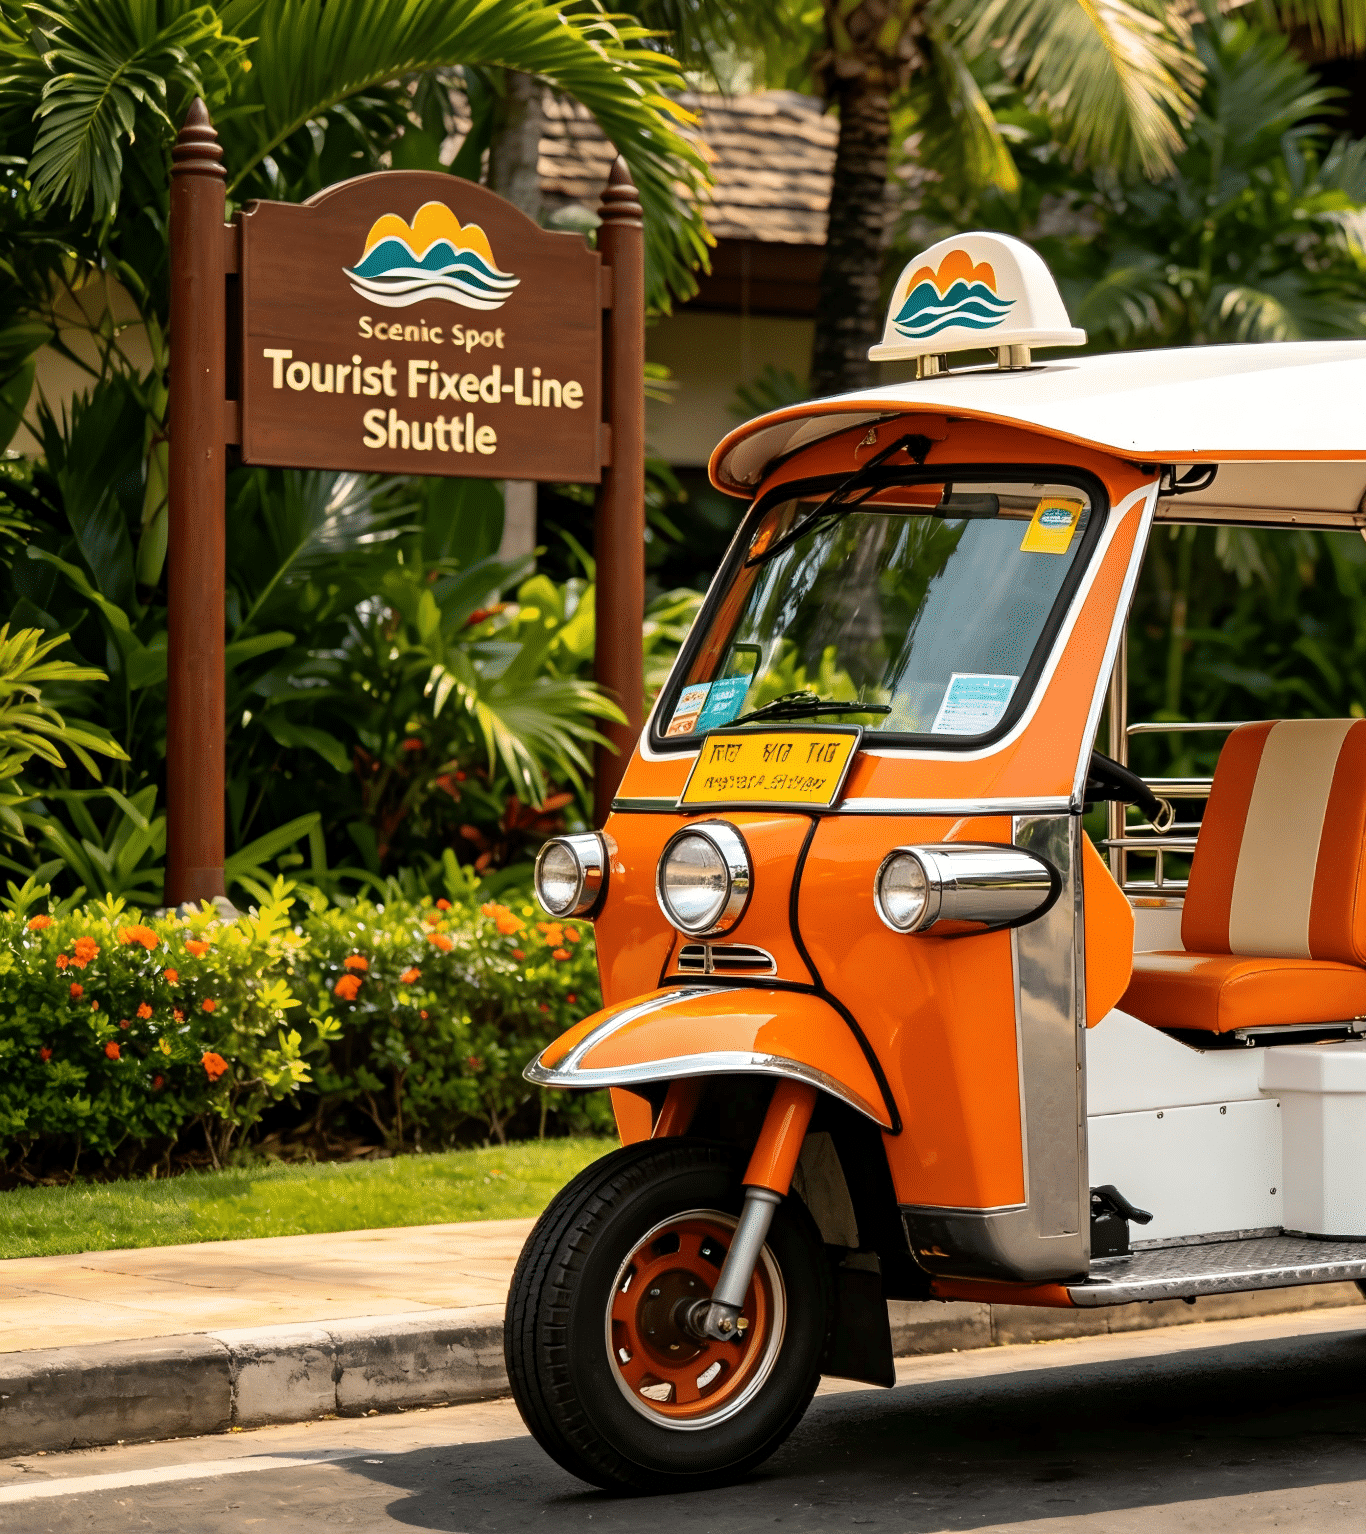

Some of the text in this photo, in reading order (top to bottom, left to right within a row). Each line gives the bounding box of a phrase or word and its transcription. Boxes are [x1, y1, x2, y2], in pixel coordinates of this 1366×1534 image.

[358, 315, 505, 353] Scenic Spot
[263, 348, 584, 409] Tourist Fixed-Line
[362, 408, 498, 455] Shuttle
